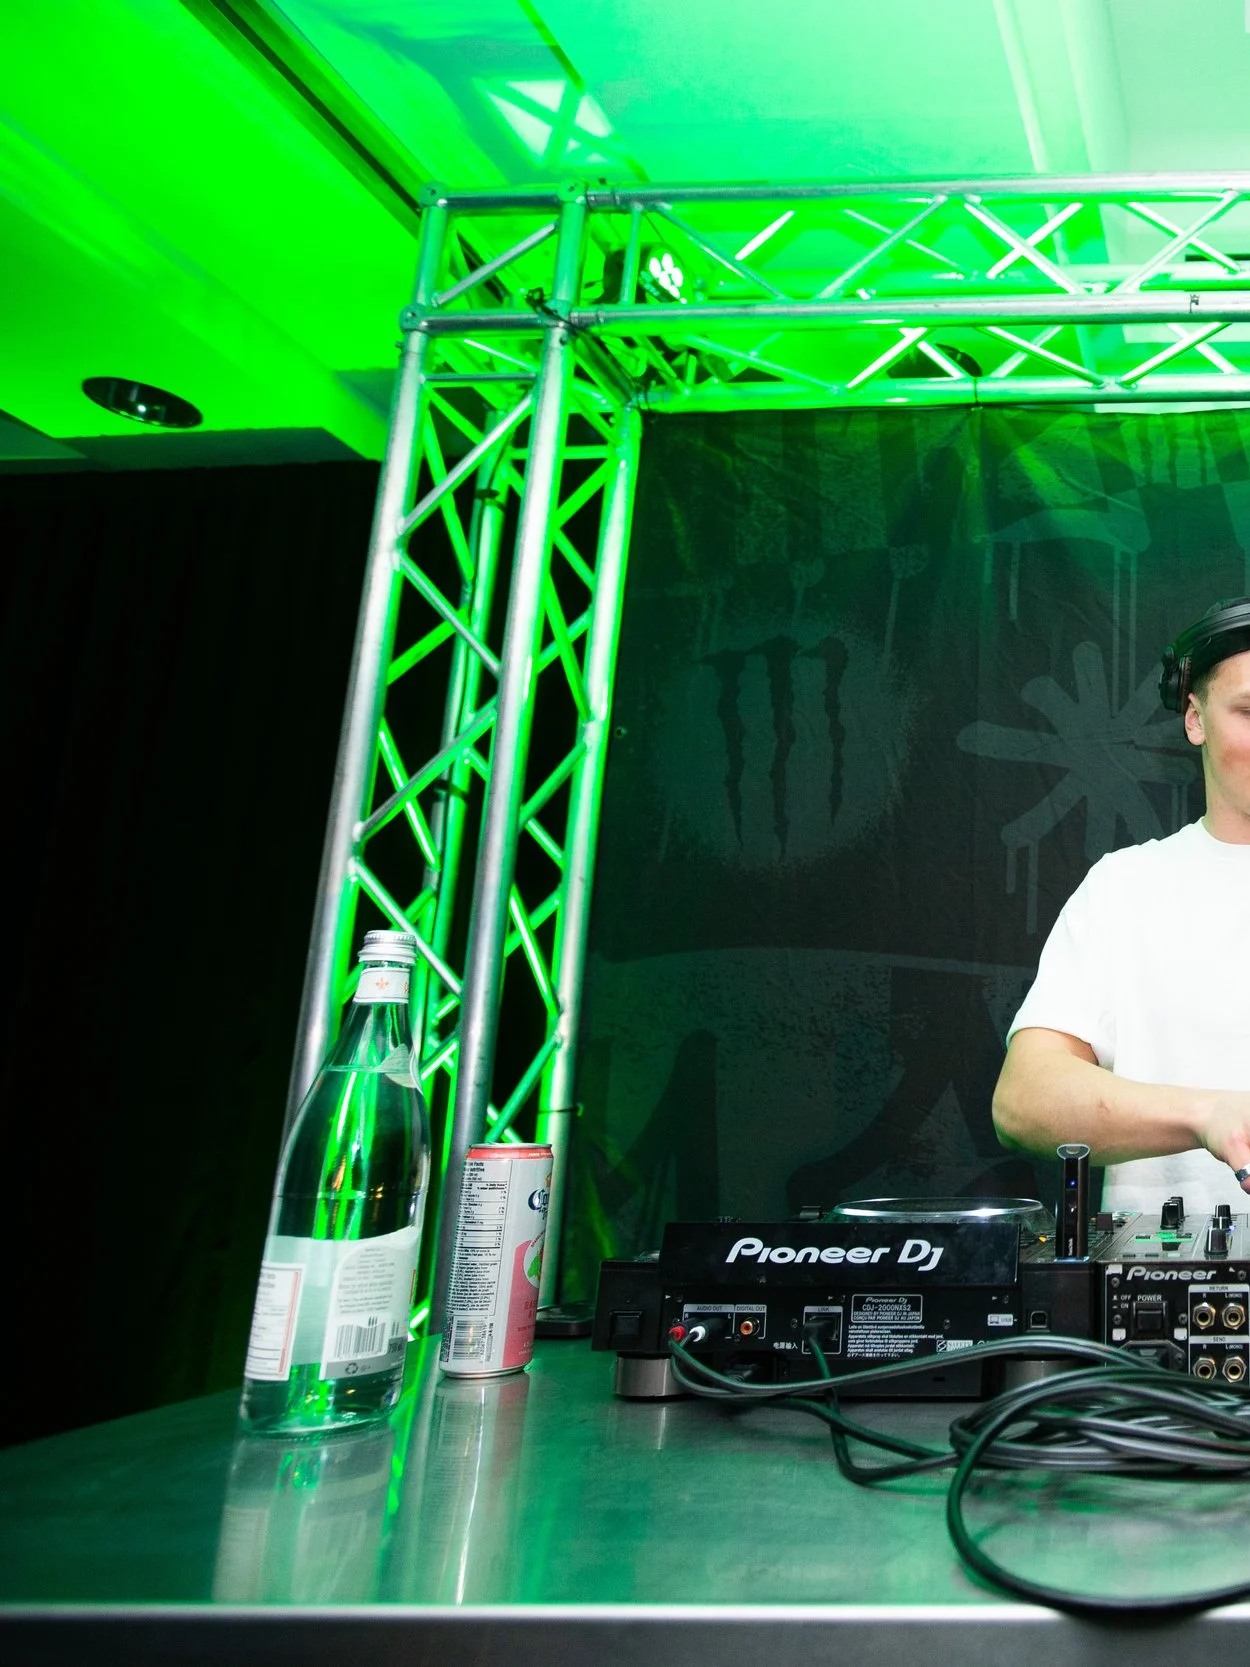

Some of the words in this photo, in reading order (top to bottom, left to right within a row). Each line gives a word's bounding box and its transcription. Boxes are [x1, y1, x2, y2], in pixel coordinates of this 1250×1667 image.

[725, 1237, 891, 1264] Pioneer
[1126, 1265, 1217, 1280] Pioneer
[773, 1342, 798, 1350] 电源输入
